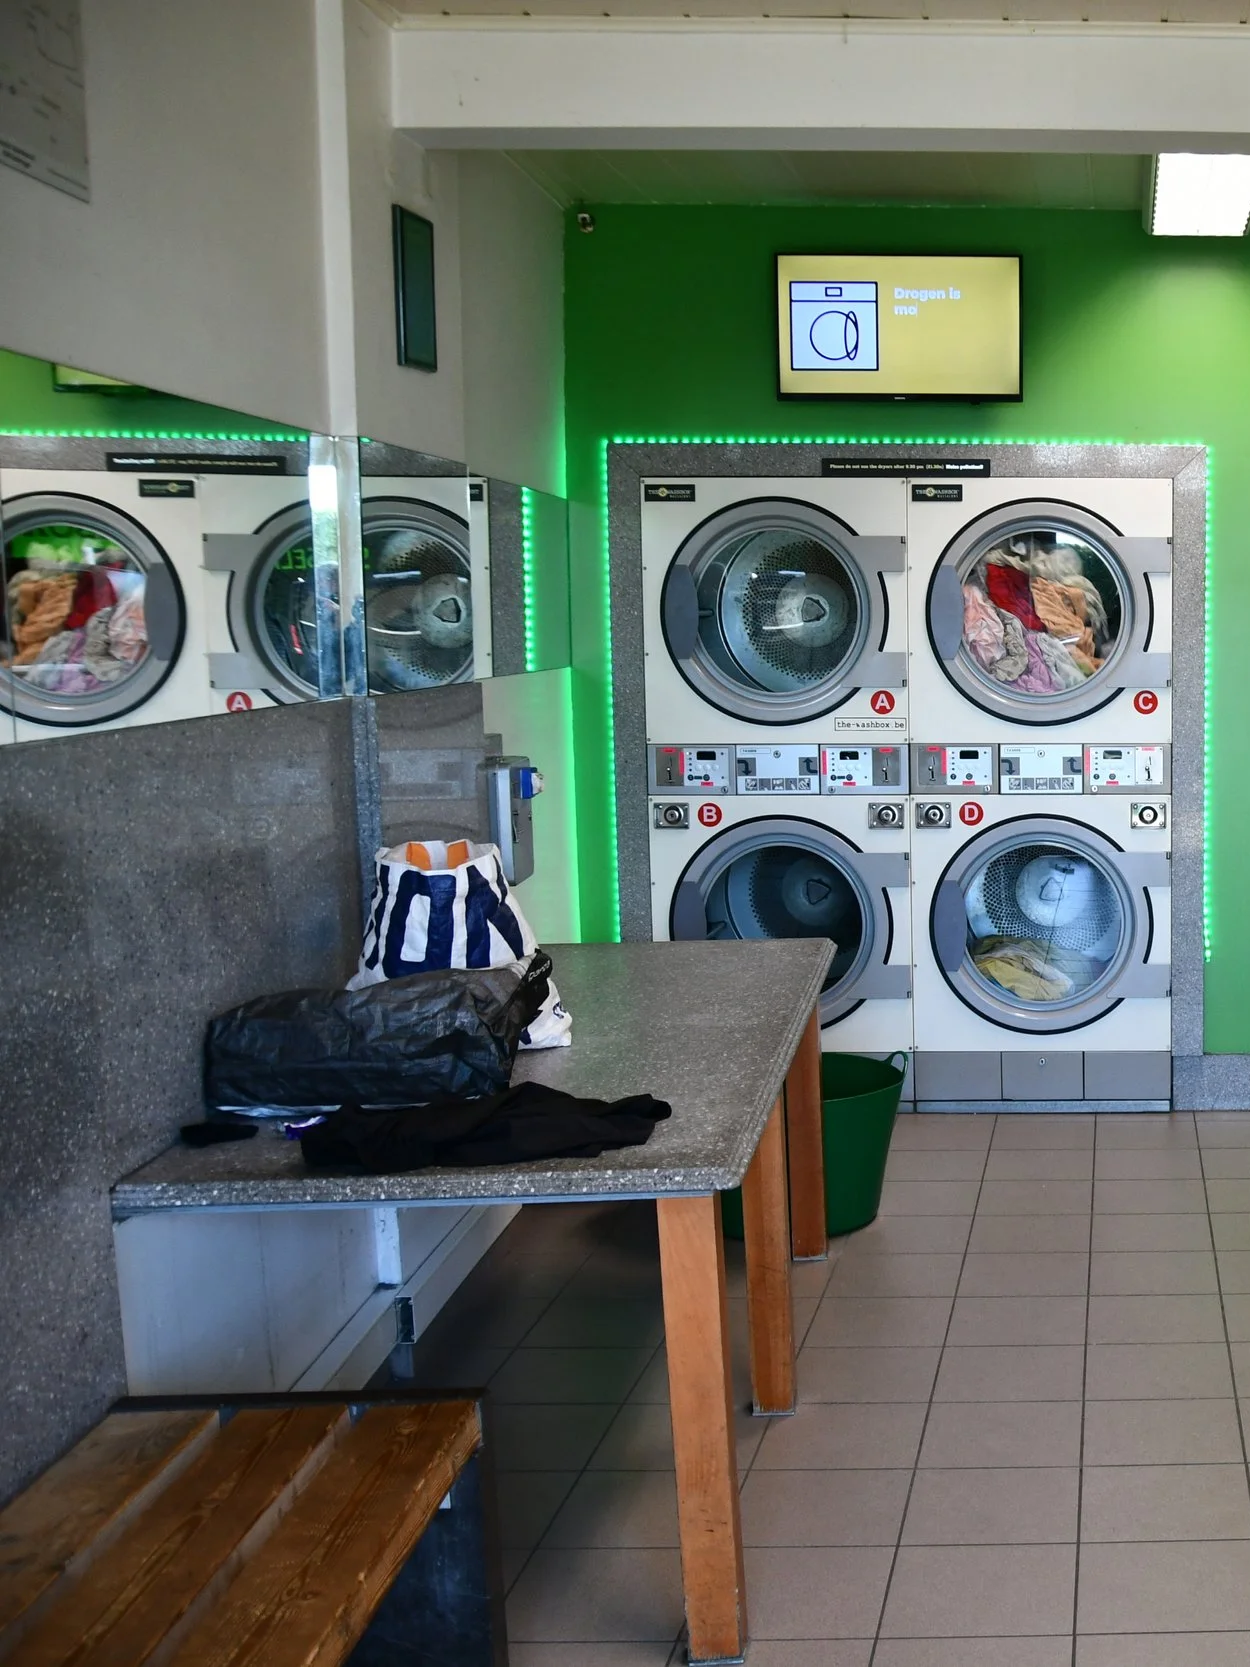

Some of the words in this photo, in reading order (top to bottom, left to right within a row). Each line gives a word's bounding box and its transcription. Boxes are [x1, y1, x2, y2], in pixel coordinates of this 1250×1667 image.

[894, 287, 946, 301] Drogen
[949, 287, 961, 300] is
[875, 693, 891, 710] A
[1138, 692, 1154, 710] C
[703, 806, 718, 823] B
[964, 805, 979, 822] D
